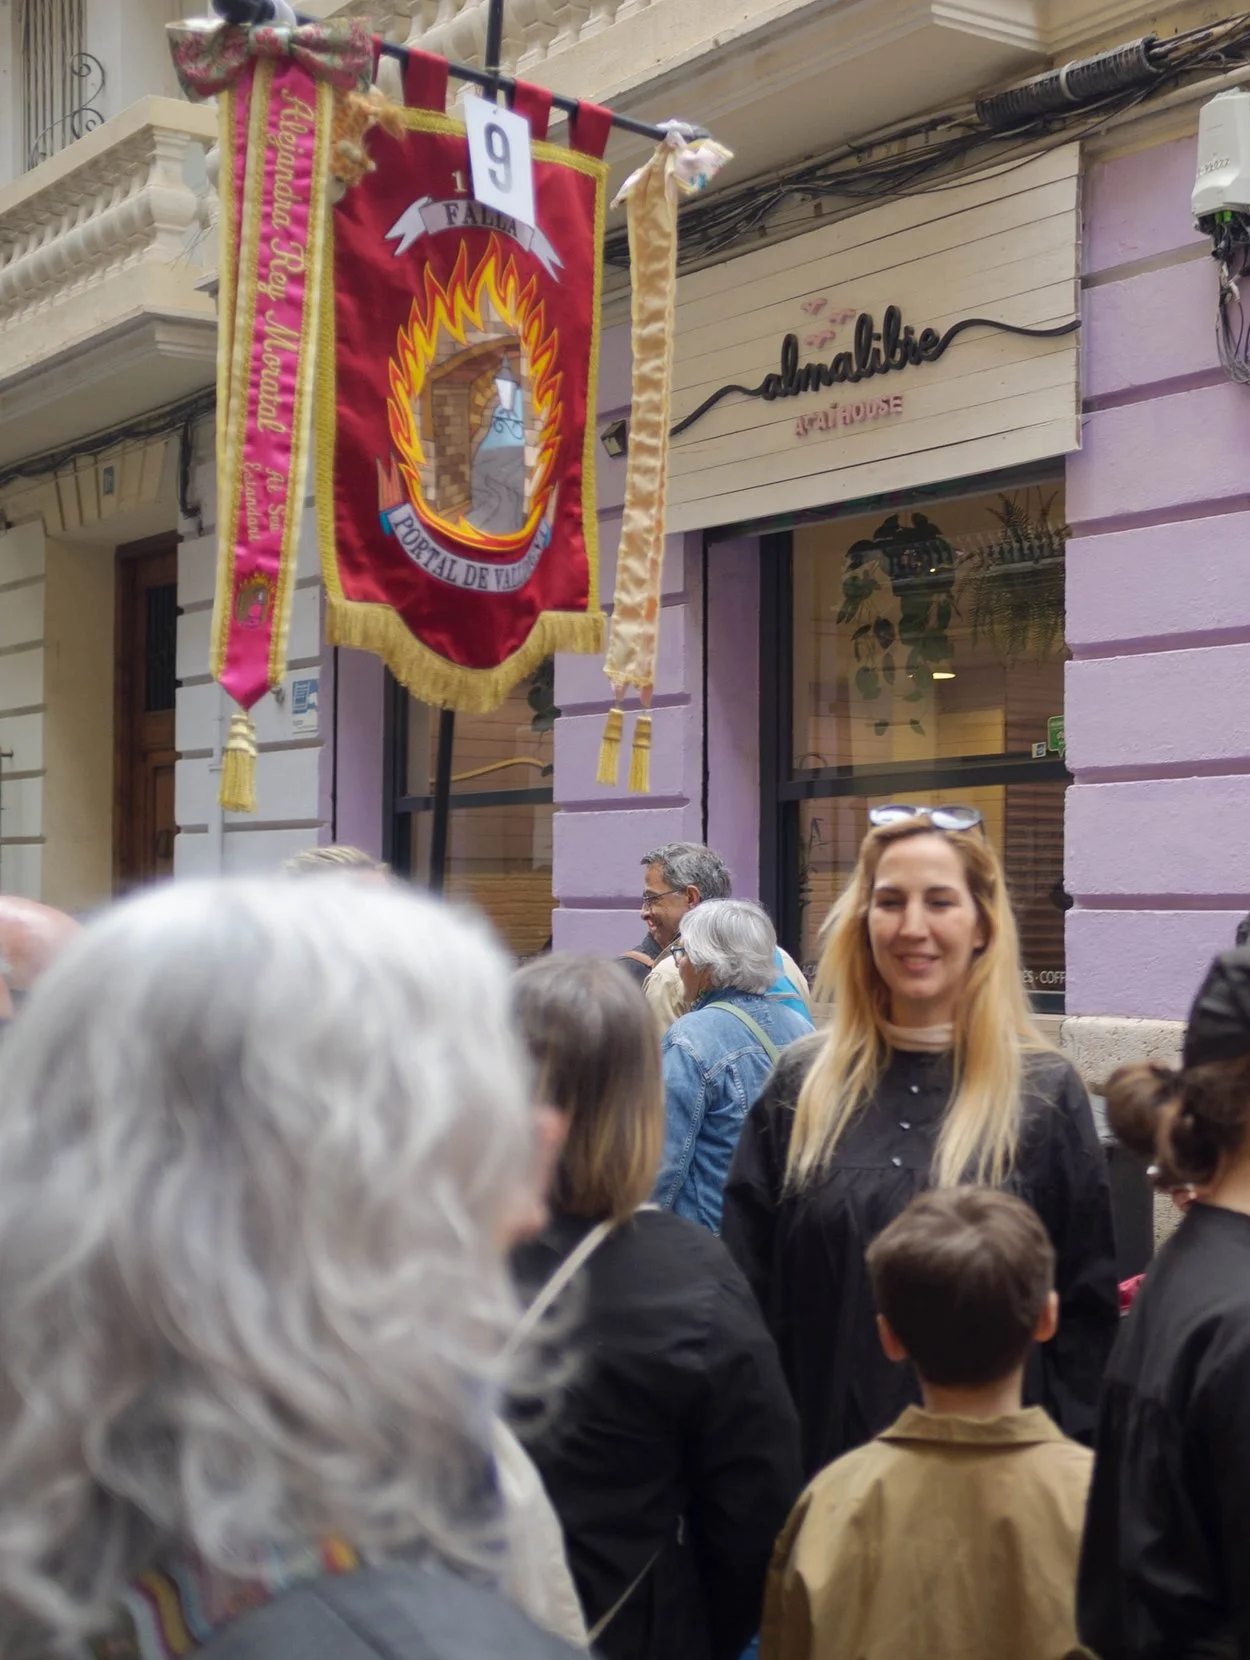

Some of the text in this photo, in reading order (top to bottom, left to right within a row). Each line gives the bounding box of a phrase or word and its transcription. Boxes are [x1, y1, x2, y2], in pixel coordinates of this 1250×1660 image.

[484, 122, 513, 194] 9
[443, 202, 518, 238] FALLA
[257, 88, 315, 434] Alejandra Rey Moratal
[761, 304, 943, 400] almalibre
[841, 393, 903, 426] HOUSE
[394, 514, 458, 583] PORTAL
[464, 565, 490, 590] DE
